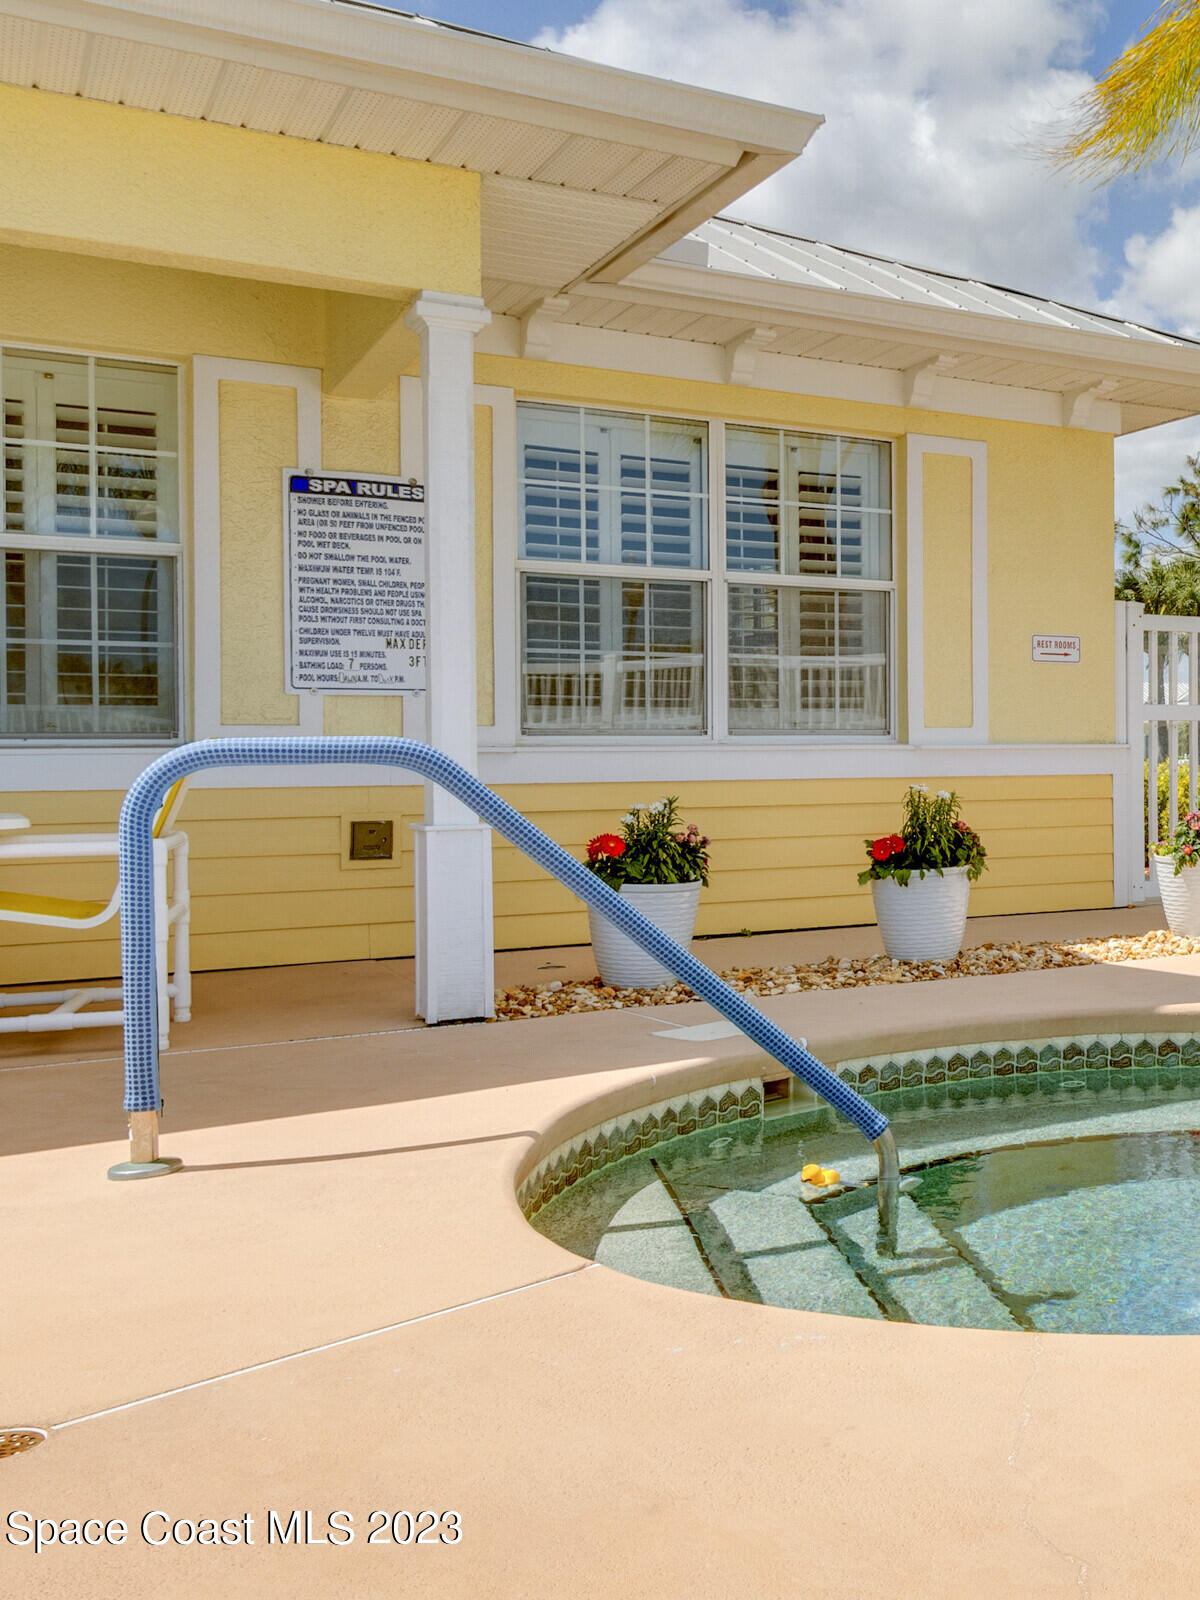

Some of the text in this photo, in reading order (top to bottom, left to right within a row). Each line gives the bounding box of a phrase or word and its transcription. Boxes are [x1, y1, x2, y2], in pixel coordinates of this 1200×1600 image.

[309, 479, 424, 499] SPA RULES
[328, 498, 352, 507] BEFORE
[355, 501, 388, 509] ENTERING.
[309, 510, 329, 518] GLASS
[342, 512, 370, 520] ANIMALS
[394, 515, 416, 523] FENCED
[317, 519, 328, 528] (OR
[339, 521, 354, 529] FEET
[356, 522, 374, 530] FROM
[376, 523, 407, 532] UNFENCED
[308, 531, 327, 539] FOOD
[339, 532, 376, 542] BEVERAGES
[386, 535, 402, 544] POOL
[297, 540, 315, 548] POOL
[324, 554, 355, 562] SWALLOW
[389, 557, 411, 565] WATER.
[298, 564, 330, 573] MAXIMUM
[332, 566, 354, 574] WATER
[356, 567, 374, 575] TEMP.
[384, 568, 395, 576] 104
[298, 577, 331, 585] PREGNANT
[333, 578, 356, 587] WOMEN,
[379, 581, 408, 589] CHILDREN,
[341, 588, 372, 596] PROBLEMS
[387, 590, 409, 598] PEOPLE
[410, 591, 425, 599] USIN
[299, 597, 328, 605] ALCOHOL,
[330, 598, 364, 606] NARCOTICS
[375, 599, 394, 607] OTHER
[396, 600, 415, 608] DRUGS
[321, 607, 359, 615] DROWSINESS
[320, 616, 348, 624] WITHOUT
[412, 630, 425, 638] ADUL
[386, 638, 425, 649] MAX DEP
[1037, 640, 1076, 649] REST ROOMS
[327, 662, 344, 670] LOAD:
[348, 658, 354, 670] 7
